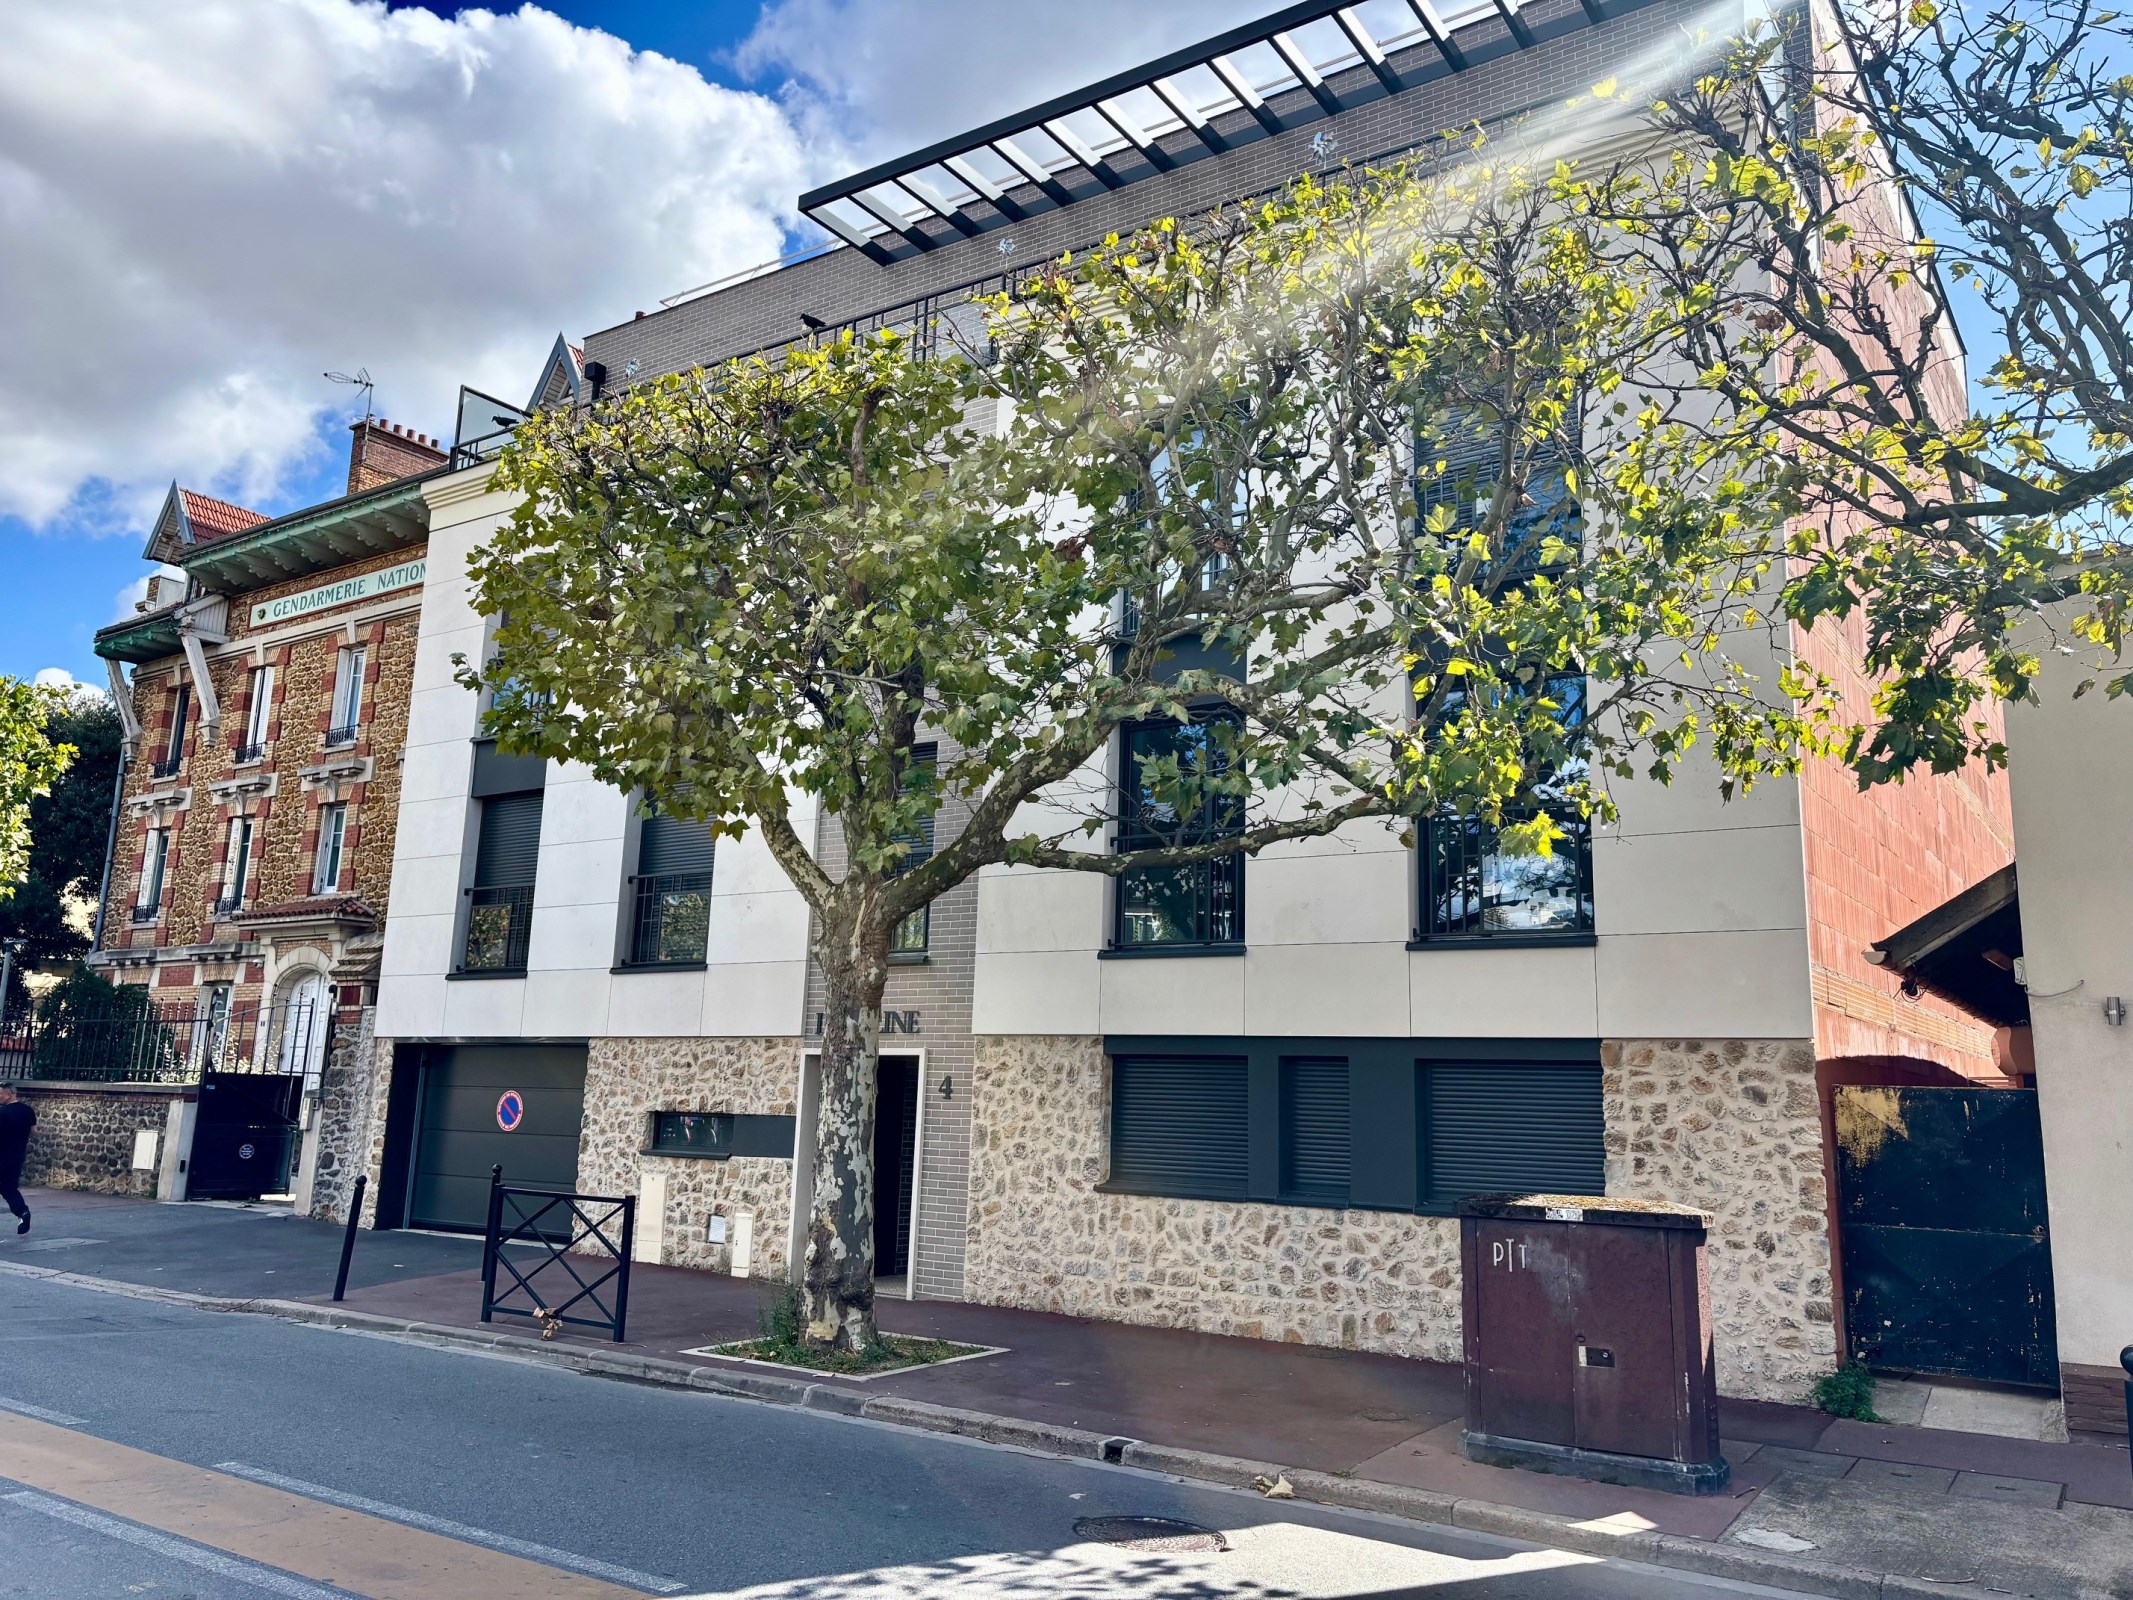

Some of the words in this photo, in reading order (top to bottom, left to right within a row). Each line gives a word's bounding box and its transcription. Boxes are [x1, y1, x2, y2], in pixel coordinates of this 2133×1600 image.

[273, 580, 366, 617] GENDARMERIE
[938, 1075, 953, 1099] 4
[1493, 1238, 1527, 1272] PTT
